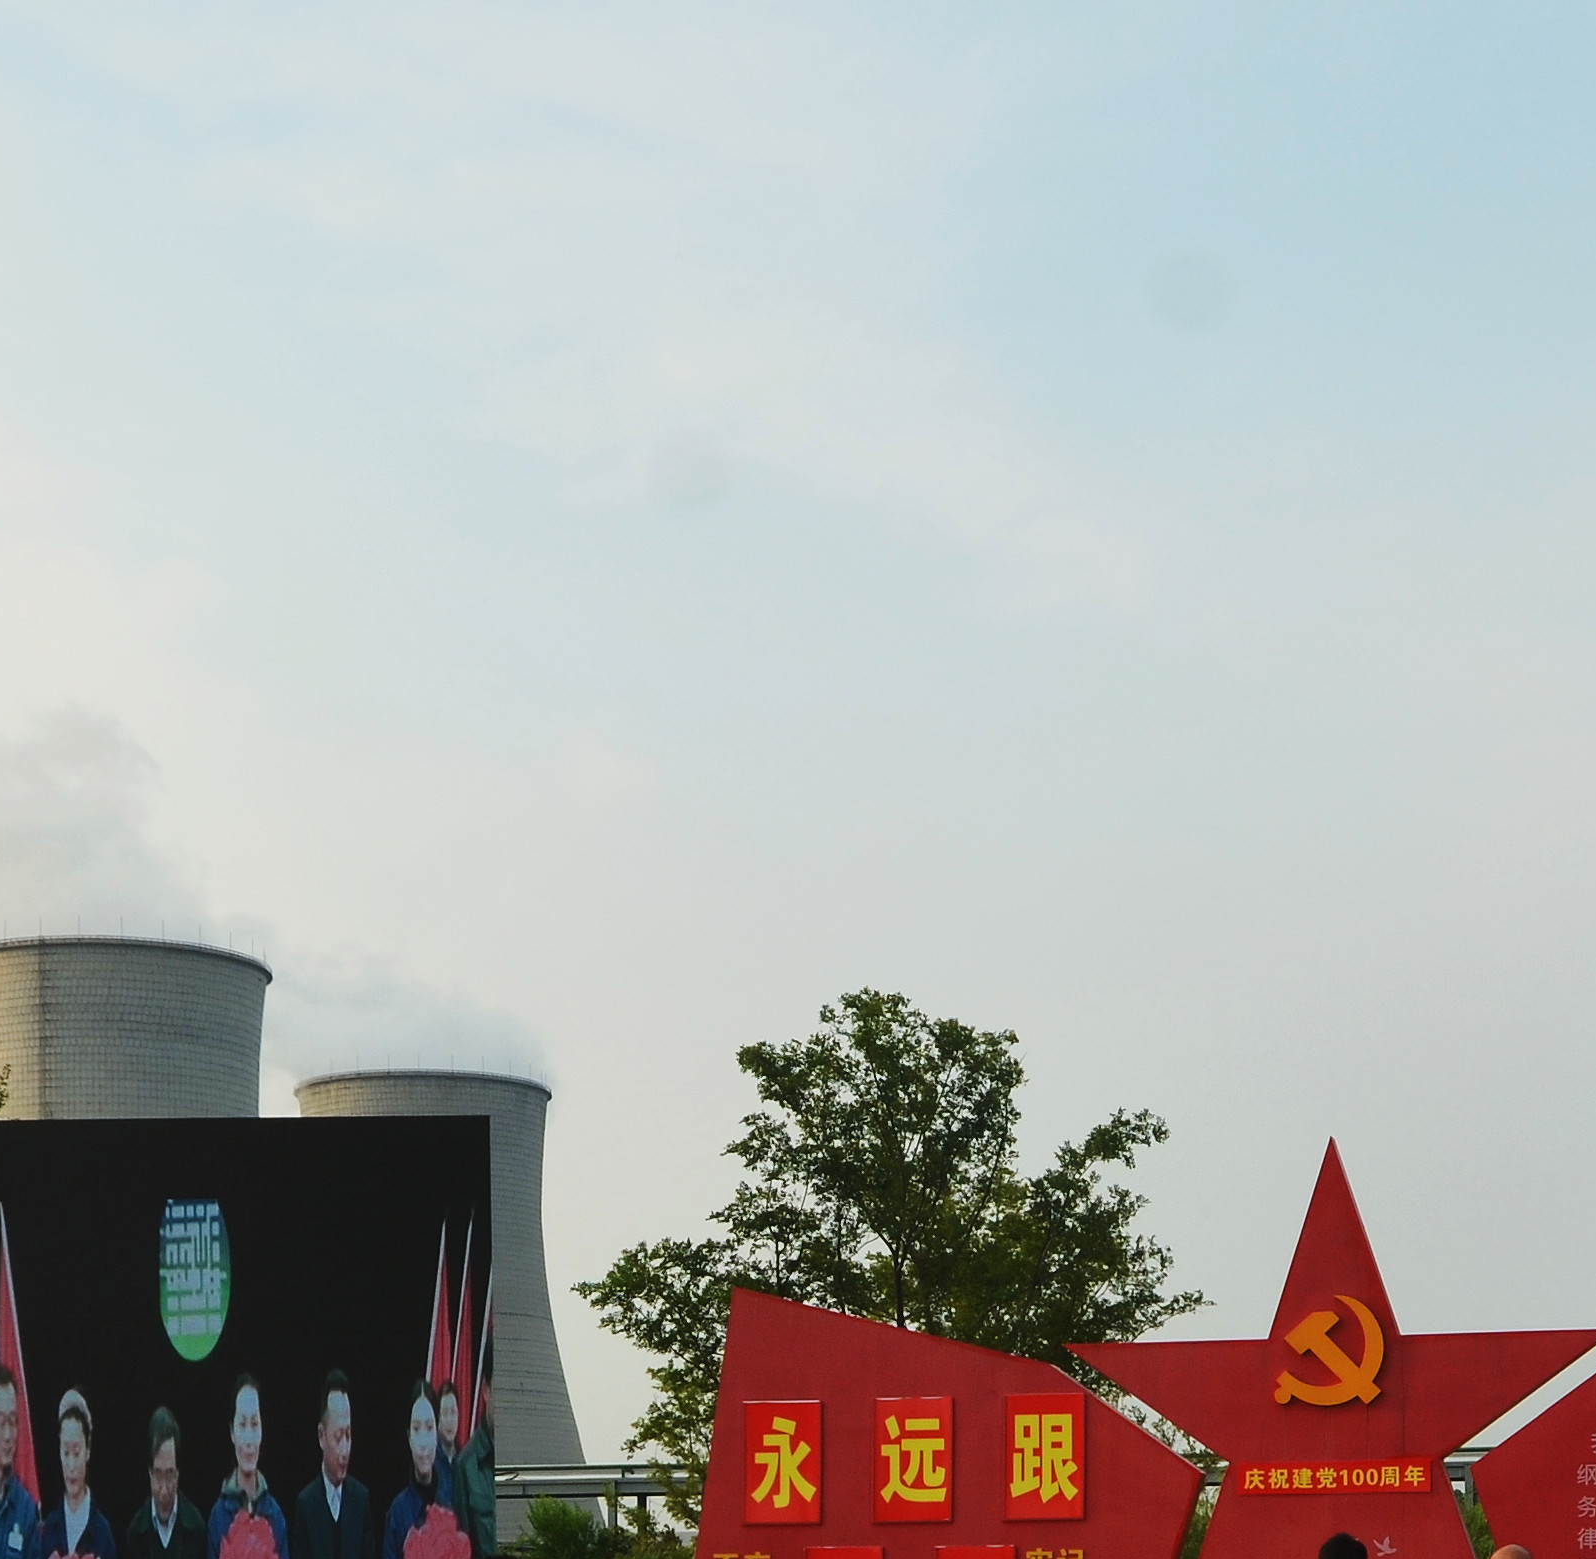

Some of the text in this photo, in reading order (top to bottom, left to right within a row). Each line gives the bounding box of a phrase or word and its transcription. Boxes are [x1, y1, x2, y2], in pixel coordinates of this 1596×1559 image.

[751, 1413, 1080, 1508] 永远跟
[1244, 1466, 1426, 1490] 庆祝建党100周年
